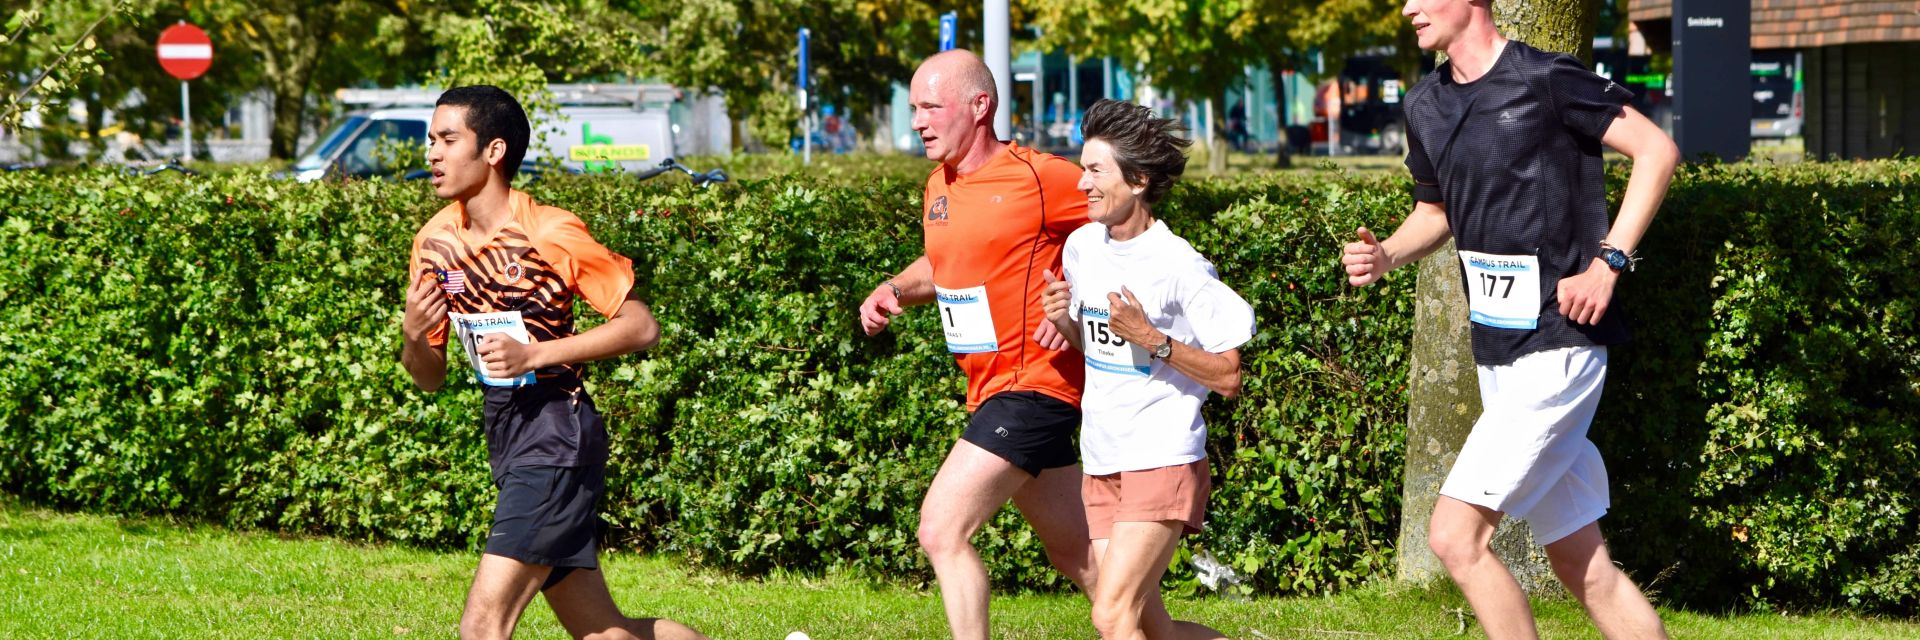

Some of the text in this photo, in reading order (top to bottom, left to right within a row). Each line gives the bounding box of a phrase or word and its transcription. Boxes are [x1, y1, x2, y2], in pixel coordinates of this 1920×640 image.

[1470, 256, 1526, 269] CAMPUS TRAIL
[1480, 272, 1515, 299] 177
[484, 317, 512, 326] TRAIL
[945, 306, 954, 328] 1
